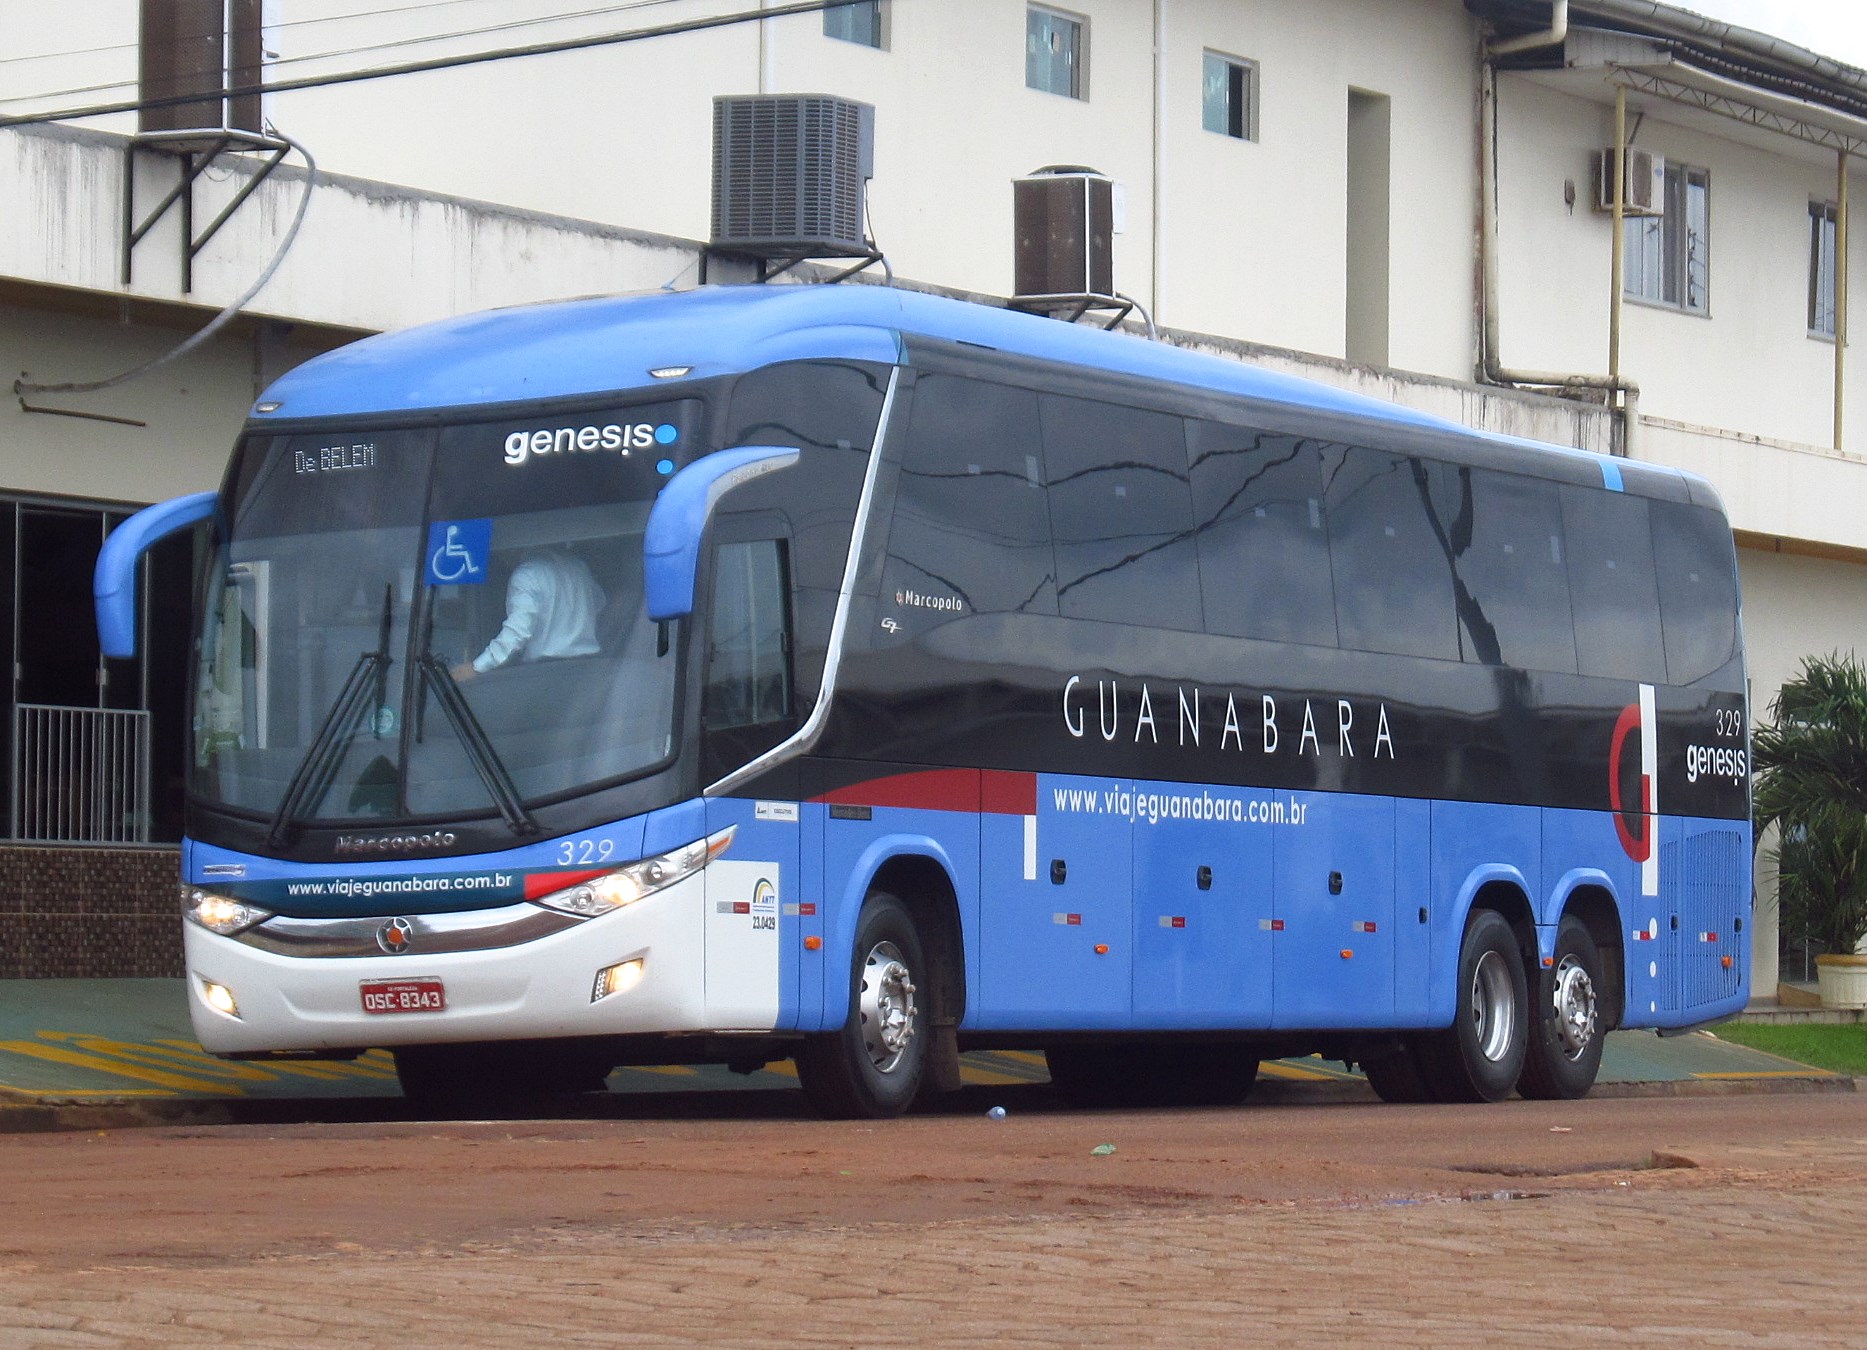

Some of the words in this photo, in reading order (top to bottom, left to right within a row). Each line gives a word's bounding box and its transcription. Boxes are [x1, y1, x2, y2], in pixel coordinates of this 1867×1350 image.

[321, 443, 374, 471] BELEM
[504, 423, 655, 465] genesis
[905, 590, 962, 611] Marcopolo
[1063, 674, 1395, 760] GUANABARA
[1715, 708, 1741, 737] 329
[1686, 744, 1746, 786] genesis
[1053, 784, 1307, 826] www.viajeguanabara.com.br
[556, 839, 615, 866] 329
[287, 872, 513, 897] www.viajeguanabara.com.br
[752, 916, 776, 930] 23.0429
